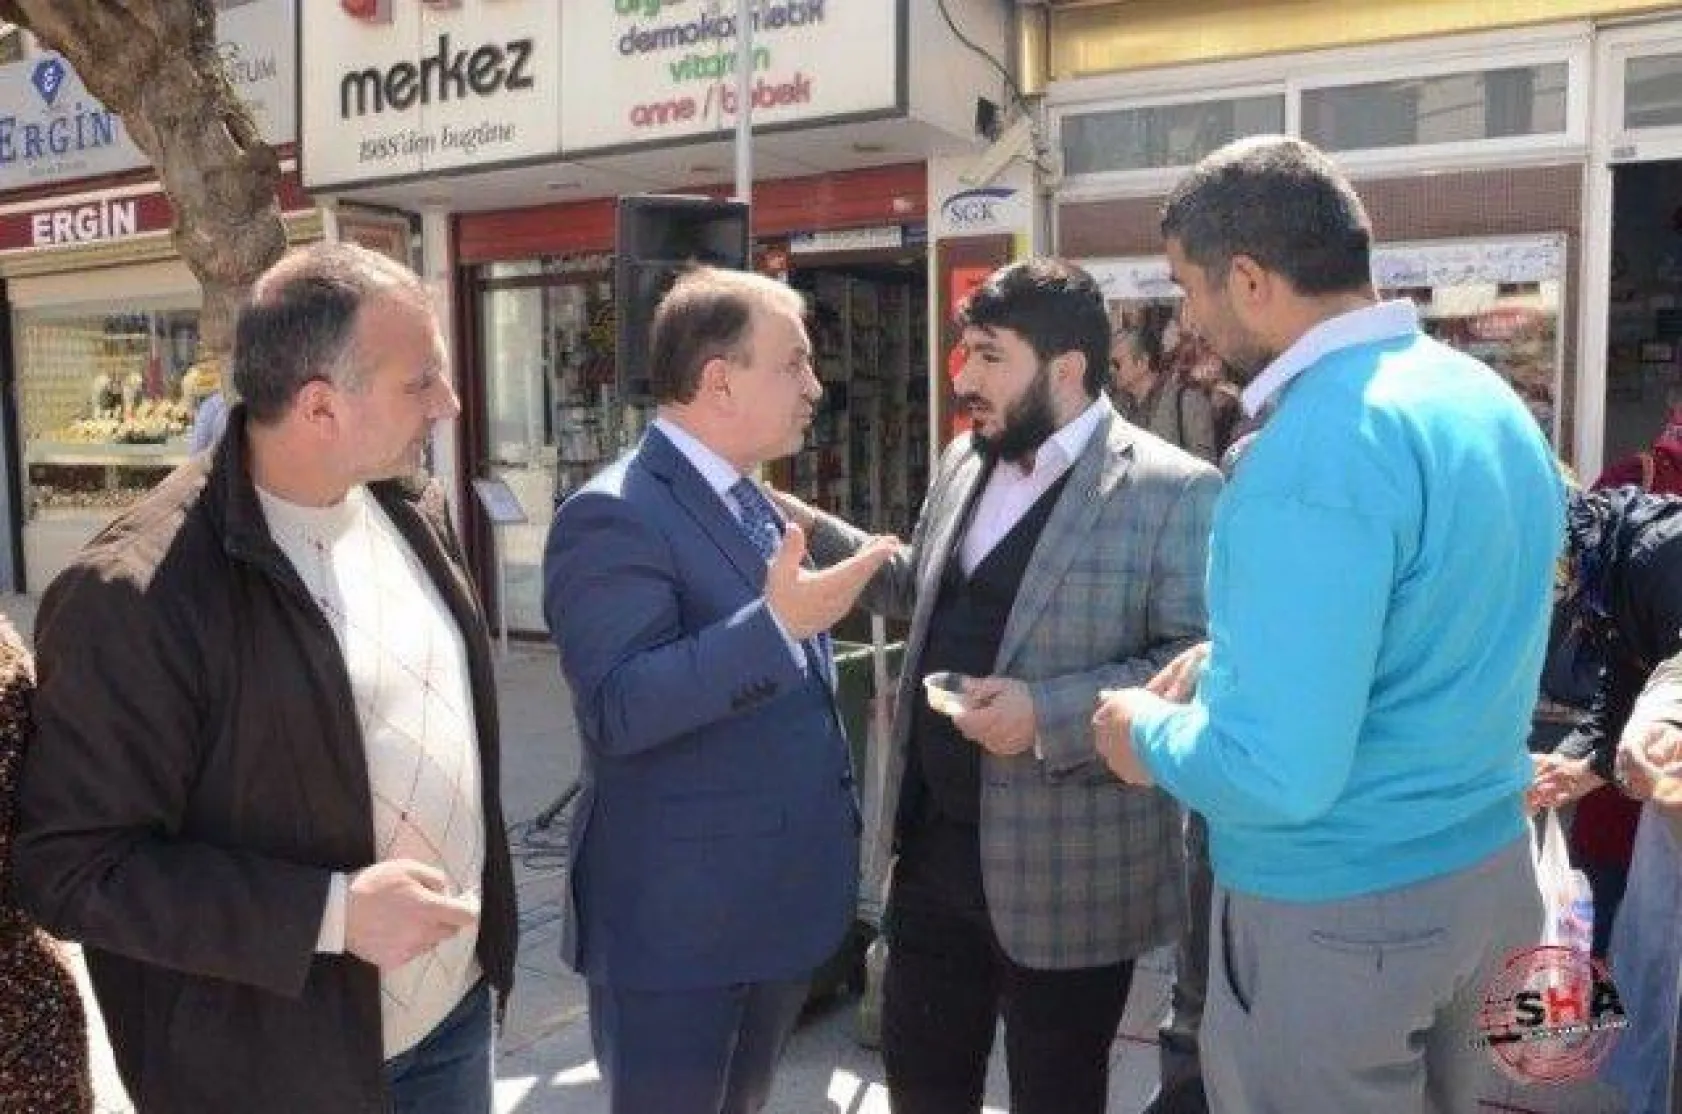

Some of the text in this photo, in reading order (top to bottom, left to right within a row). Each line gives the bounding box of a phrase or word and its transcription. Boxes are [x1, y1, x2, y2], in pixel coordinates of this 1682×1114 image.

[619, 0, 824, 55] dermokometik
[341, 33, 533, 118] merkez
[670, 46, 770, 82] vitamn
[0, 102, 115, 163] ERGİN
[630, 97, 697, 126] anne
[32, 198, 137, 247] ERGİN
